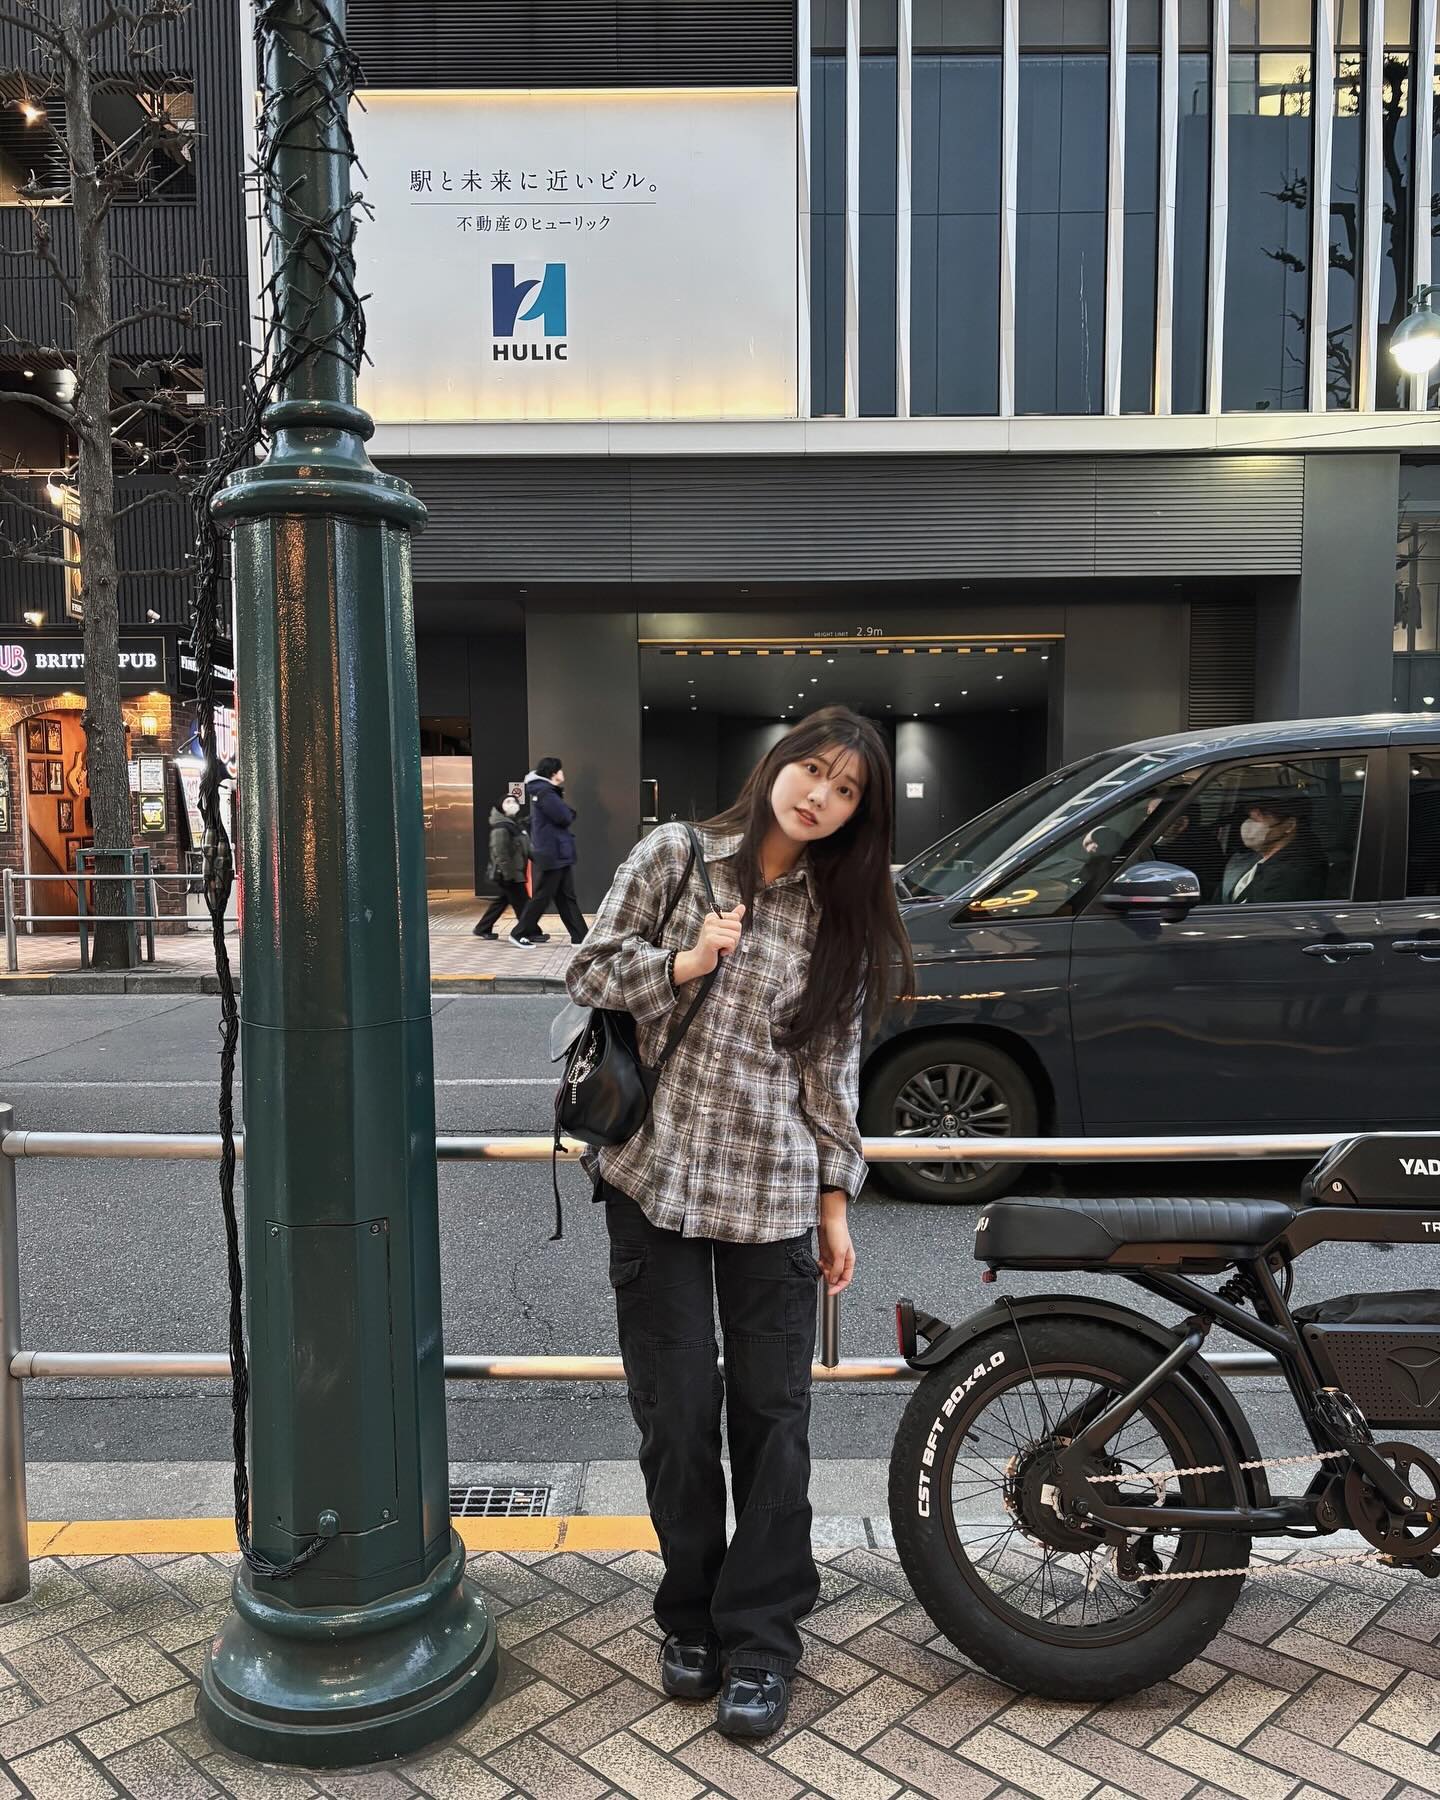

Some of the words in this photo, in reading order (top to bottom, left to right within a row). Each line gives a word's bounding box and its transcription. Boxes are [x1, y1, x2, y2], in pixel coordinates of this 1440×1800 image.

[410, 169, 657, 193] 駅と未来に近いビル。
[456, 215, 610, 232] 不動産のヒューリック
[493, 344, 568, 361] HULIC
[856, 626, 883, 637] 2.9m
[118, 653, 157, 668] PUB
[1398, 1158, 1440, 1176] YAD
[941, 1351, 1006, 1418] 20x4.0
[922, 1417, 945, 1467] BFT
[917, 1469, 931, 1518] CST
